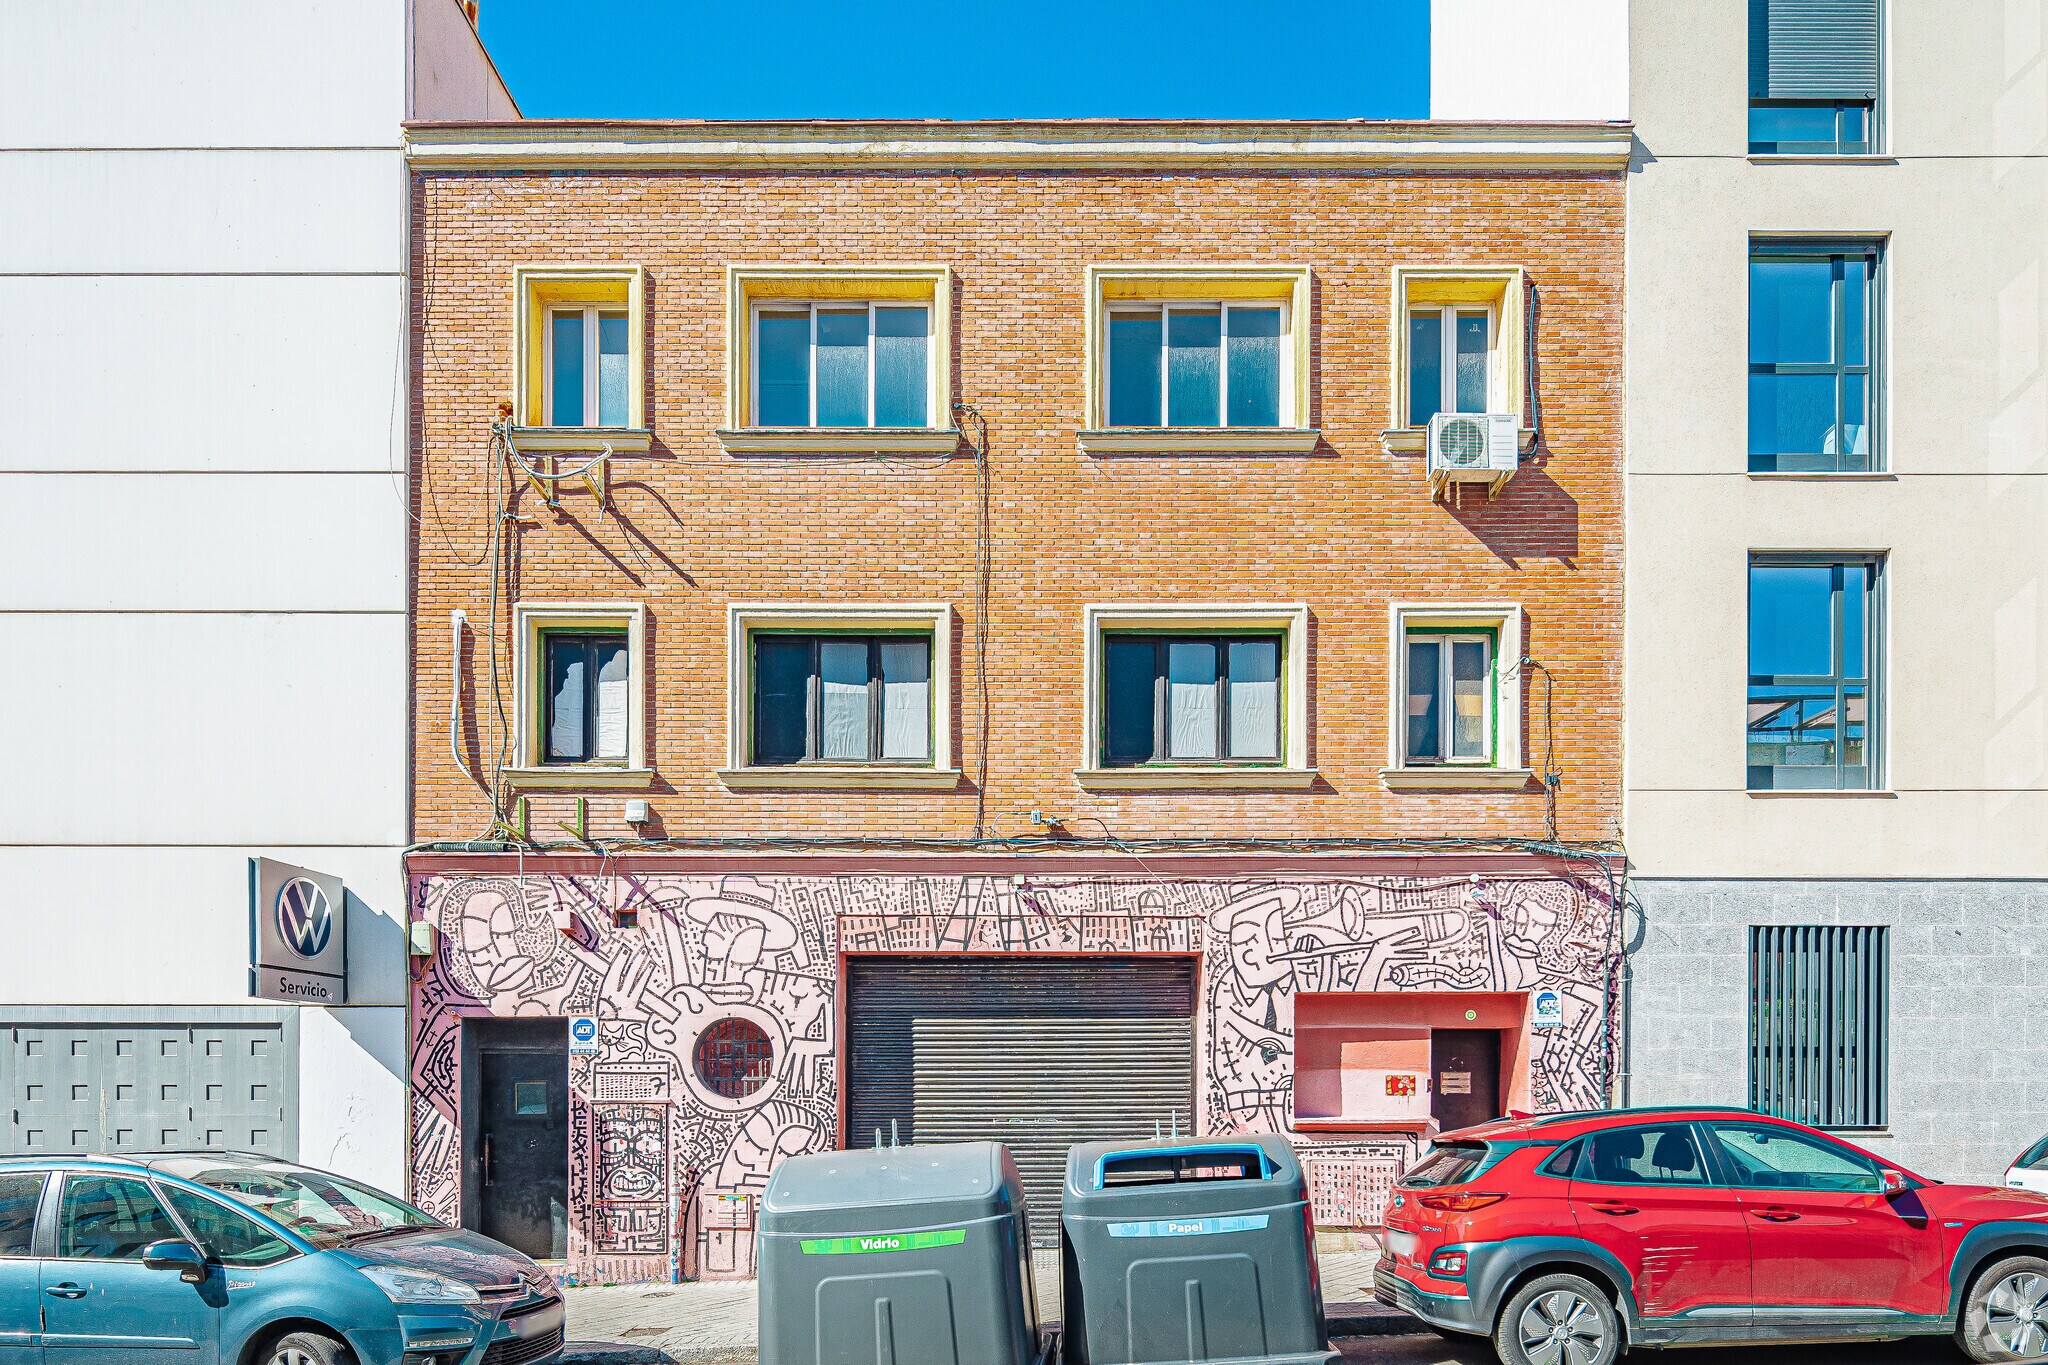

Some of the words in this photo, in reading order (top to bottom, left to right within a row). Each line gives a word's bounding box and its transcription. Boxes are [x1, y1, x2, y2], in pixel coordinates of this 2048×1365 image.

[280, 977, 327, 998] Servicio
[576, 1025, 592, 1035] ADT
[1168, 1222, 1203, 1234] Papel
[860, 1238, 900, 1250] Vidrio
